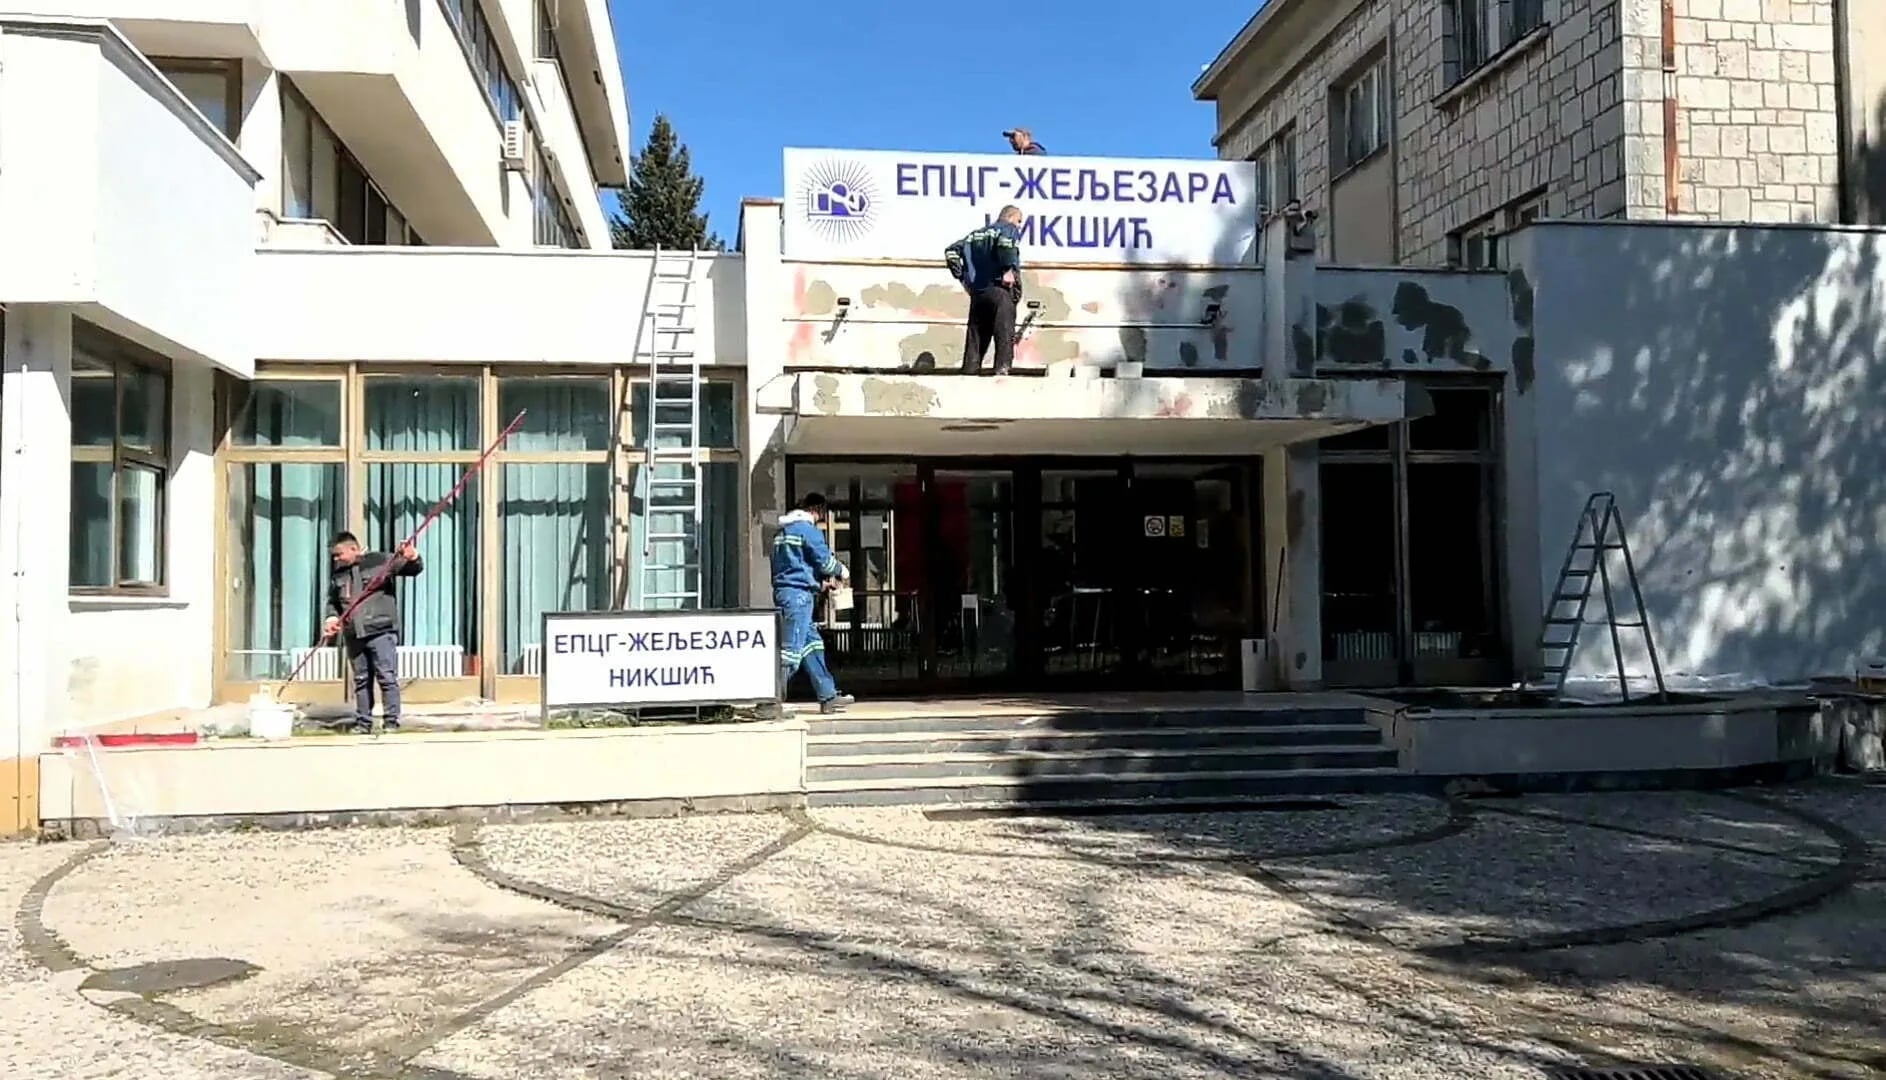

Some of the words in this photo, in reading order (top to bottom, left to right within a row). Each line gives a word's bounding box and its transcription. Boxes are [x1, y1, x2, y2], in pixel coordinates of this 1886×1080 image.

[896, 163, 1236, 206] ЕПЦГ-ЖЕЉЕЗАРА
[554, 630, 767, 657] ЕПЦГ-ЖЕЉЕЗАРА
[609, 666, 715, 688] НИКШИЋ
